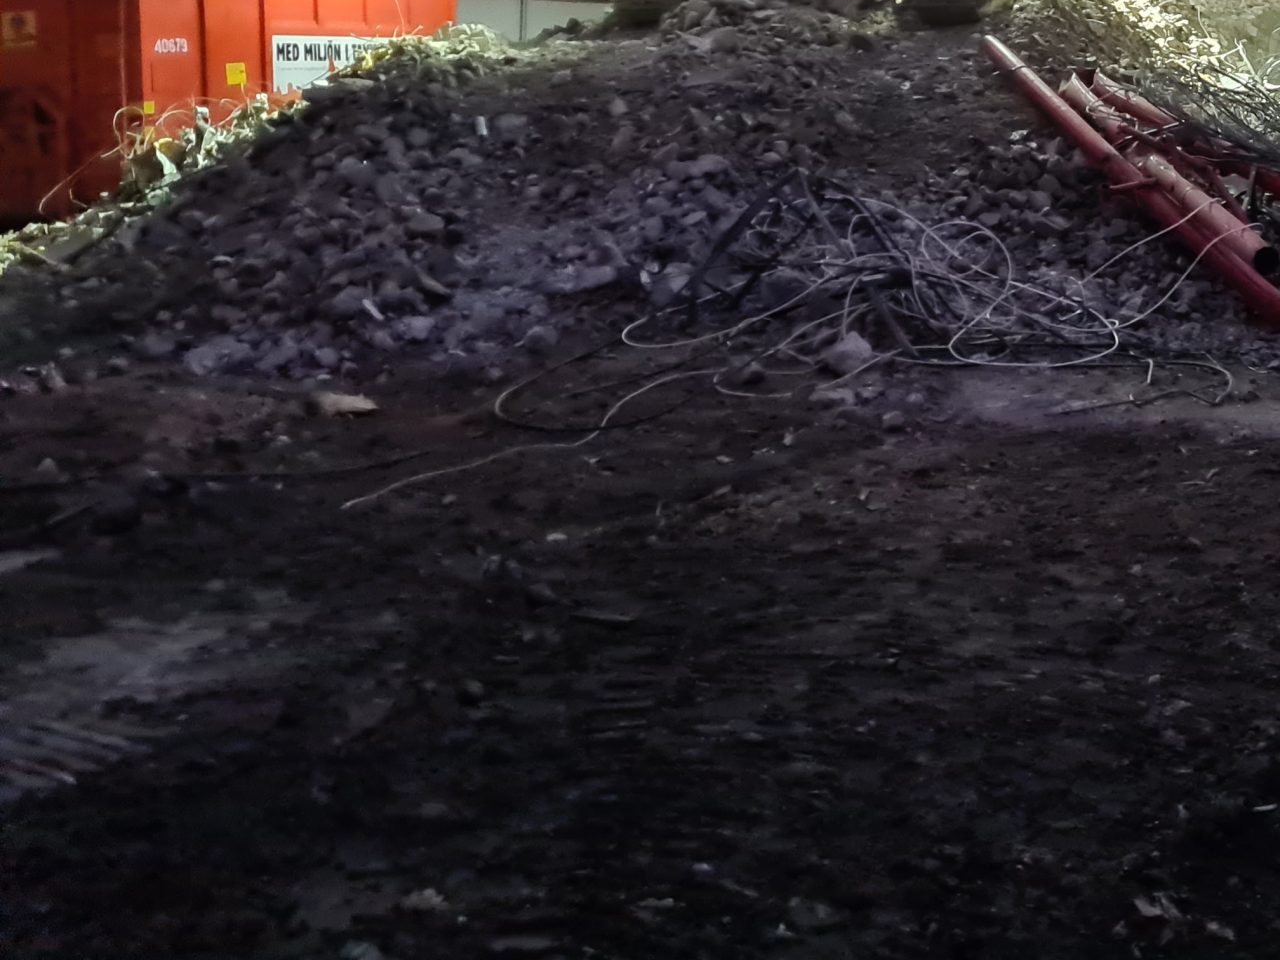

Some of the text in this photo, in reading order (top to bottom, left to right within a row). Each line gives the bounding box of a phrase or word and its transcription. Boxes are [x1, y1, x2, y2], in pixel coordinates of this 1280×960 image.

[154, 37, 188, 53] 40679
[276, 43, 299, 61] MED
[304, 40, 341, 61] MILJÖN
